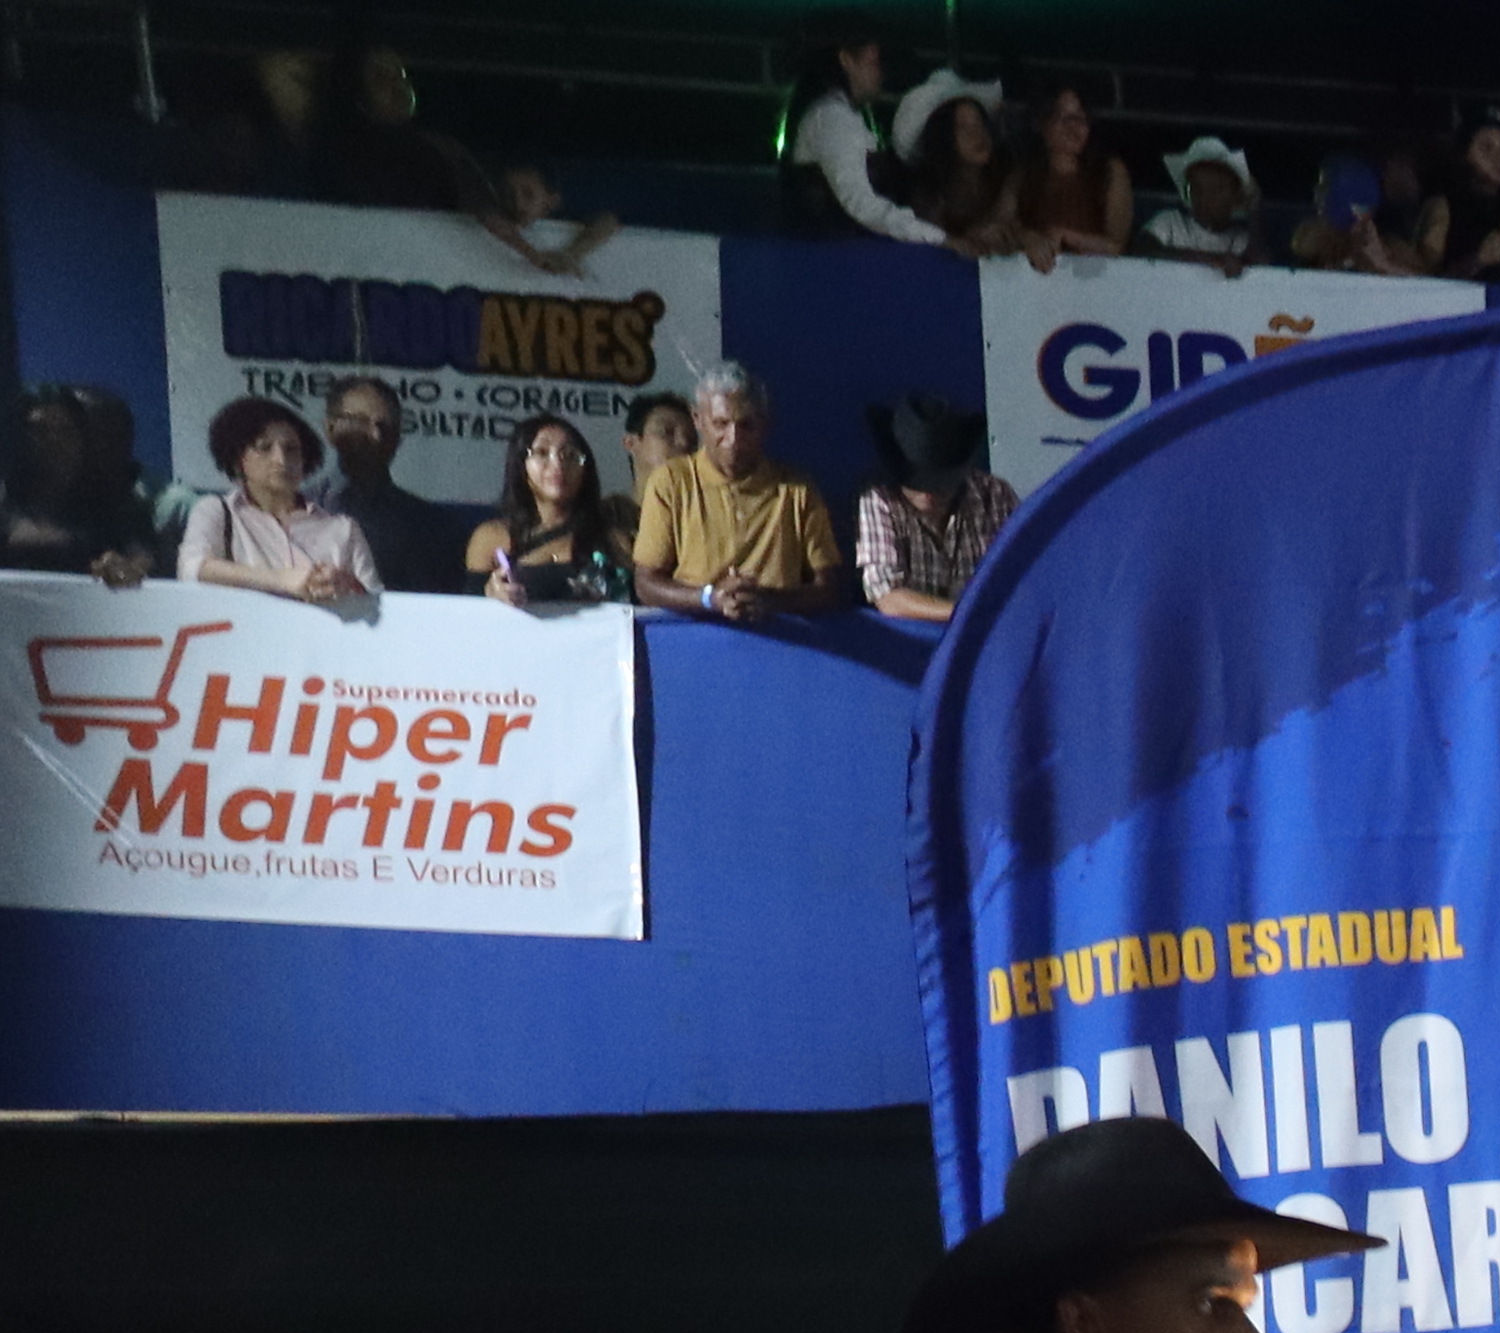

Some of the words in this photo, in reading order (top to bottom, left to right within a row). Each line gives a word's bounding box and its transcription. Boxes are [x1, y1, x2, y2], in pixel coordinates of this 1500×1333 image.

[478, 294, 650, 383] AYRES
[192, 673, 533, 782] Hiper
[332, 679, 538, 708] Supermercado
[94, 757, 577, 858] Martins
[372, 856, 394, 881] E
[407, 857, 557, 888] Verduras
[988, 926, 1216, 1025] DEPUTADO
[1228, 904, 1464, 980] ESTADUAL
